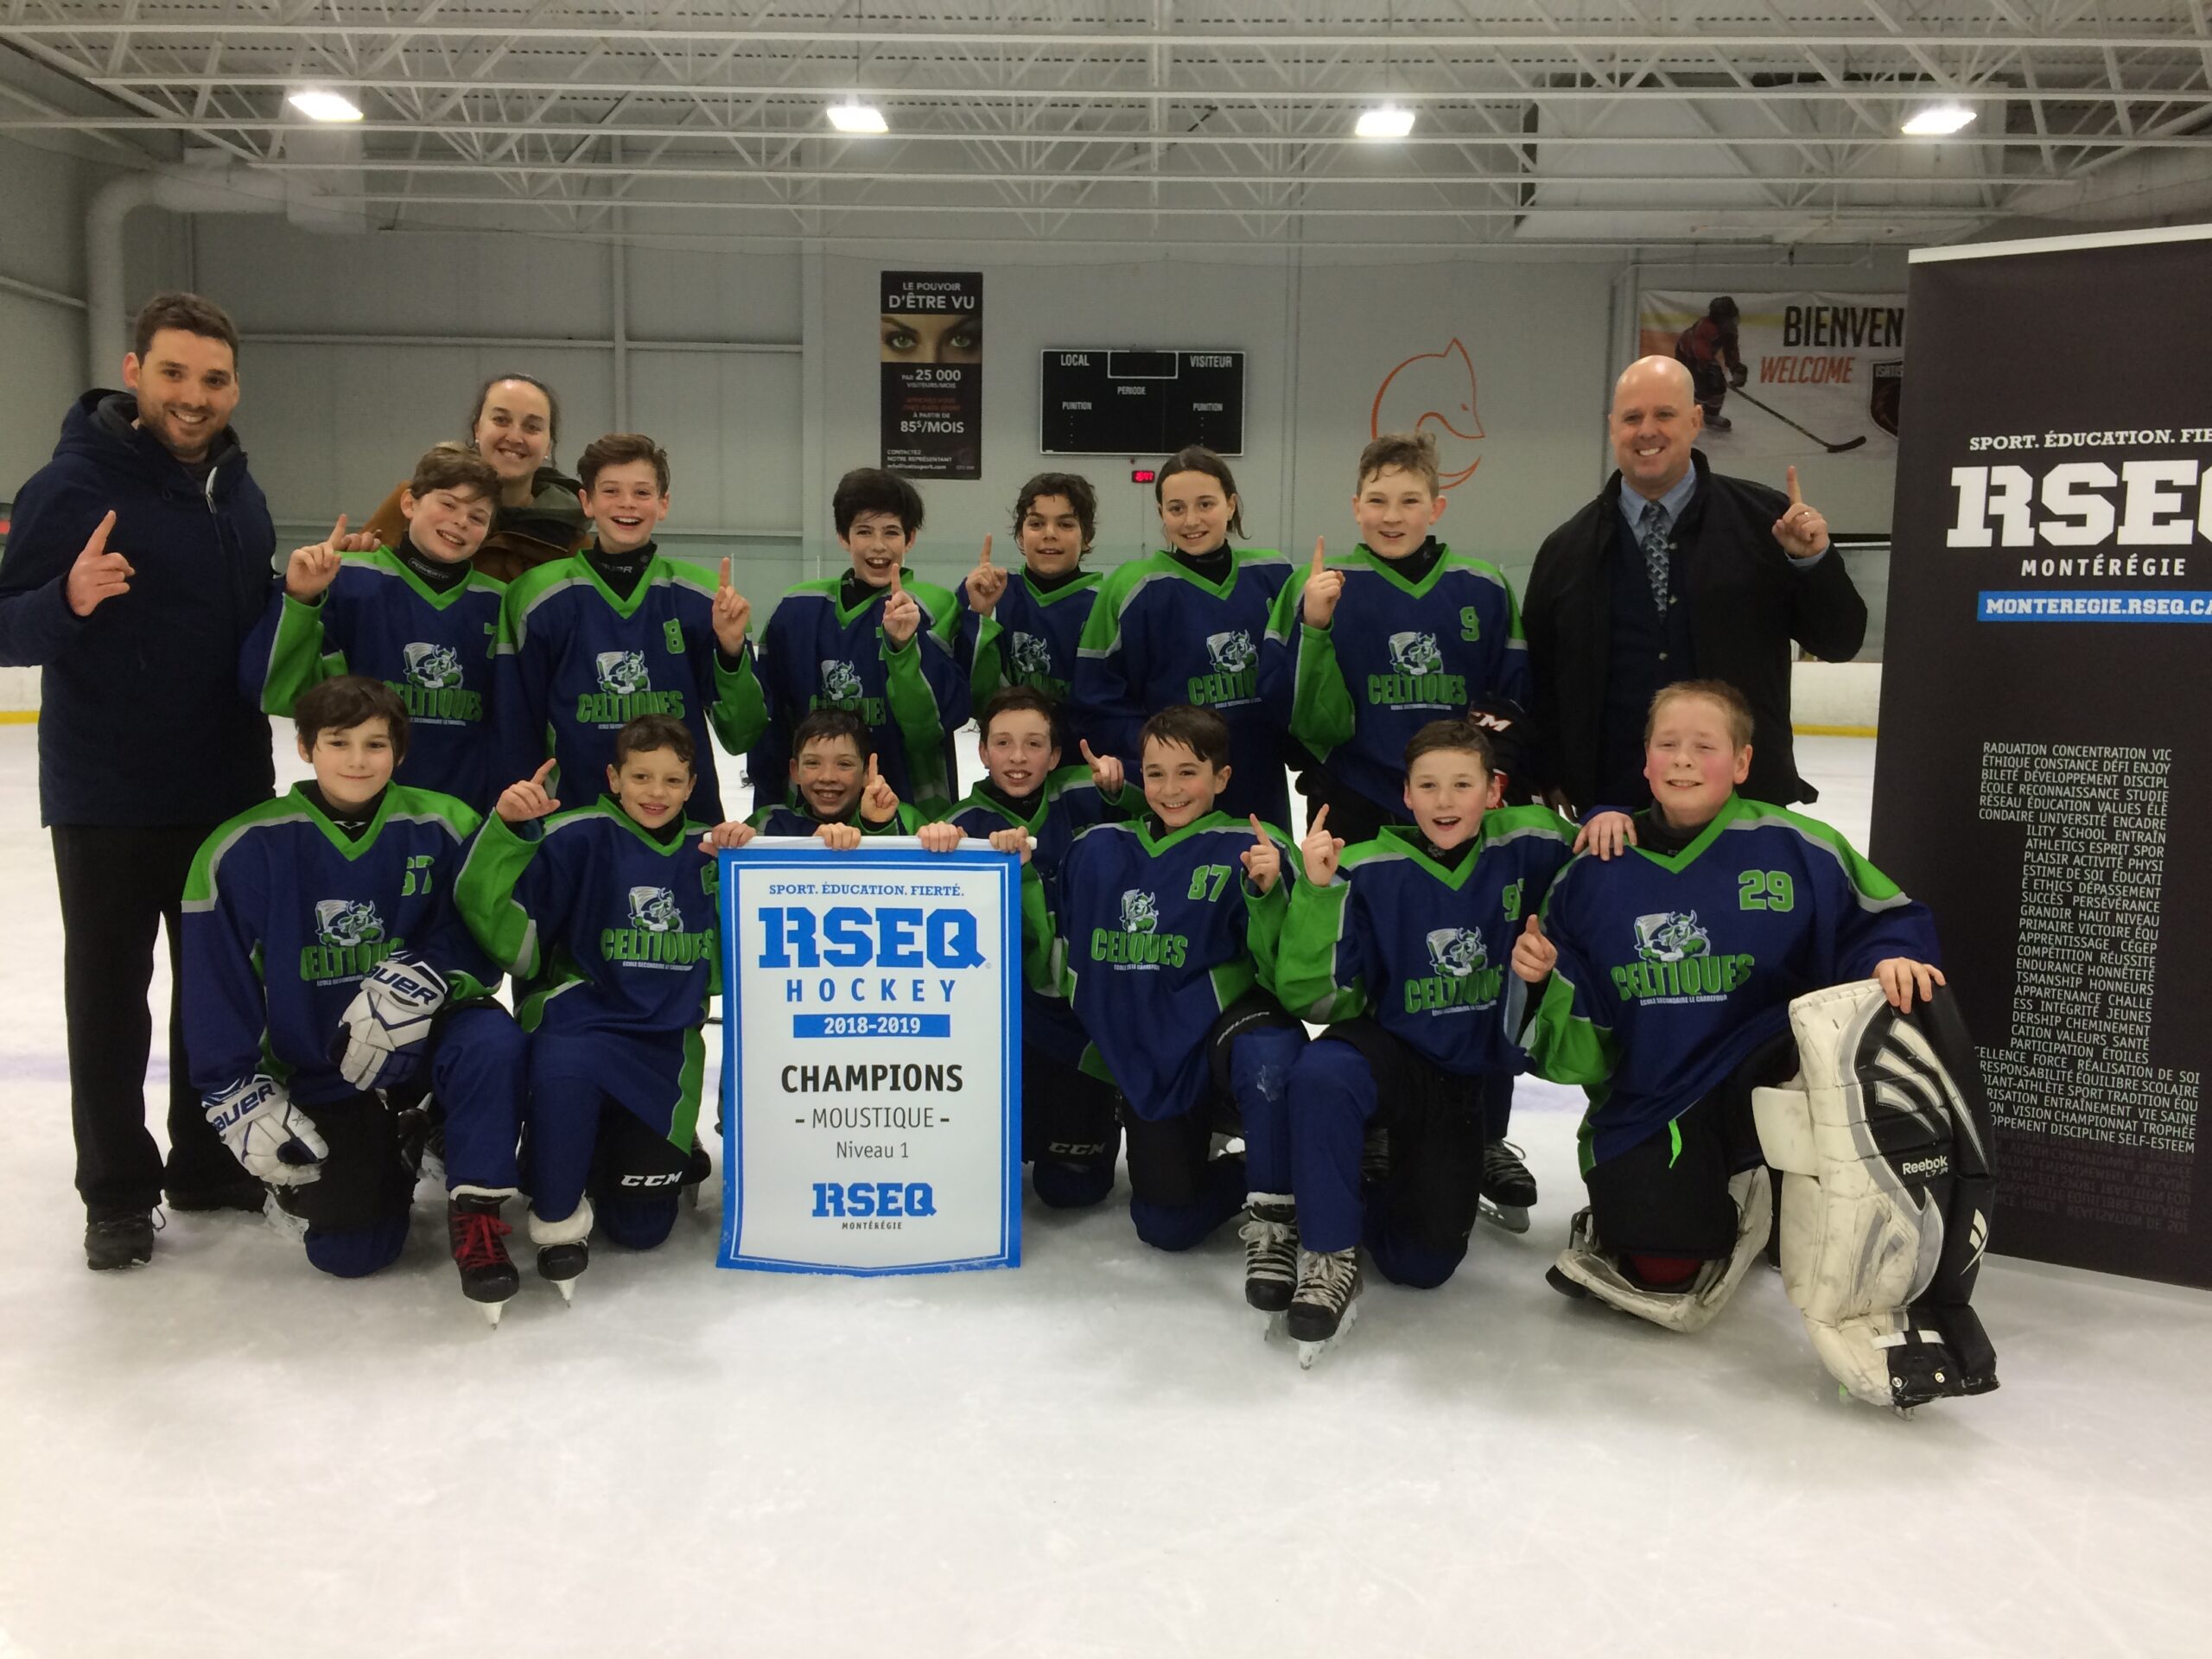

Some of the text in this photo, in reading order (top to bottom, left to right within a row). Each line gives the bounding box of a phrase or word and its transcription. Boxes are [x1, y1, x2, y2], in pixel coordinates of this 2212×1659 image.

[903, 283, 961, 291] LE POUVOIR
[951, 295, 976, 309] VU
[1783, 306, 1904, 346] BIENVEN
[1060, 353, 1090, 367] LOCAL
[1189, 354, 1233, 368] VISITEUR
[1759, 355, 1856, 385] WELCOME
[915, 369, 932, 382] 25
[936, 369, 962, 382] 000
[1062, 401, 1092, 411] PUNITION
[1192, 402, 1224, 412] PUNITION
[1969, 434, 2040, 451] SPORT.
[2044, 430, 2176, 448] ÉDUCATION.
[1946, 460, 2212, 548] RSE
[2021, 553, 2186, 577] MONTÉRÉGIE
[1459, 606, 1480, 642] 9
[663, 618, 685, 655] 8
[1367, 673, 1467, 706] CELTIQUES
[1983, 741, 2172, 761] RADUATION CONCENTRATION VIC
[1982, 753, 2171, 775] ÉTHIQUE CONSTANCE DÉFI ENJOY
[1981, 767, 2170, 789] BILETÉ DÉVELOPPEMENT DISCIPL
[1980, 779, 2170, 804] ÉCOLE RECONNAISSANCE STUDIE
[1980, 792, 2022, 809] RÉSEAU
[2027, 795, 2091, 812] ÉDUCATION
[2097, 801, 2141, 815] VALUES
[1978, 808, 2167, 830] CONDAIRE UNIVERSITÉ ENCADRE
[2026, 823, 2166, 844] ILITY SCHOOL ENTRAÎN
[2024, 837, 2164, 858] ATHLETICS ESPRIT SPOR
[2024, 850, 2164, 872] PLAISIR ACTIVITÉ PHYSI
[1187, 864, 1232, 902] 87
[2023, 864, 2163, 886] ESTIME DE SOI ÉDUCATI
[769, 881, 965, 897] SPORT. ÉDUCATION. FIERTÉ.
[1738, 869, 1795, 912] 29
[2033, 878, 2073, 893] ETHICS
[2078, 880, 2162, 899] DÉPASSEMENT
[2021, 890, 2161, 913] SUCCÈS PERSÉVÉRANCE
[2020, 904, 2160, 927] GRANDIR HAUT NIVEAU
[758, 906, 987, 969] RSEQ
[2018, 917, 2158, 941] PRIMAIRE VICTOIRE ÉQU
[2018, 931, 2158, 954] APPRENTISSAGE CÉGEP
[2017, 944, 2156, 969] COMPÉTITION RÉUSSITE
[1610, 953, 1755, 1001] CELTIQUES
[2016, 957, 2156, 982] ENDURANCE HONNÊTETÉ
[786, 977, 956, 1002] HOCKEY
[2016, 970, 2154, 996] TSMANSHIP HONNEURS
[2014, 984, 2152, 1010] APPARTENANCE CHALLE
[2013, 997, 2152, 1024] ESS INTÉGRITÉ JEUNES
[823, 1016, 921, 1034] 2018-2019
[2012, 1010, 2151, 1037] DERSHIP CHEMINEMENT
[2011, 1024, 2150, 1051] CATION VALEURS SANTÉ
[2010, 1037, 2149, 1065] PARTICIPATION ÉTOILES
[781, 1063, 963, 1093] CHAMPIONS
[1980, 1060, 2199, 1098] RESPONSABILITÉ ÉQUILIBRE SCOLAIRE
[2033, 1053, 2068, 1069] FORCE
[2077, 1057, 2153, 1079] RÉALISATION
[2158, 1067, 2173, 1081] DE
[2178, 1071, 2201, 1084] SOI
[1986, 1087, 2196, 1126] RISATION ENTRAÎNEMENT VIE SAINE
[2067, 1084, 2104, 1100] SPORT
[2107, 1089, 2171, 1109] TRADITION
[2174, 1096, 2198, 1112] ÉQU
[2012, 1103, 2052, 1121] VISION
[2054, 1109, 2139, 1132] CHAMPIONNAT
[2142, 1122, 2196, 1140] TROPHÉE
[836, 1141, 909, 1159] Niveau 1
[1048, 1141, 1107, 1155] CCM
[2050, 1122, 2116, 1143] DISCIPLINE
[2118, 1132, 2195, 1154] SELF-ESTEEM
[1902, 1155, 1948, 1175] Reebok
[620, 1171, 683, 1188] CCM
[811, 1182, 938, 1217] RSEQ
[842, 1220, 902, 1230] MONTÉRÉGIE
